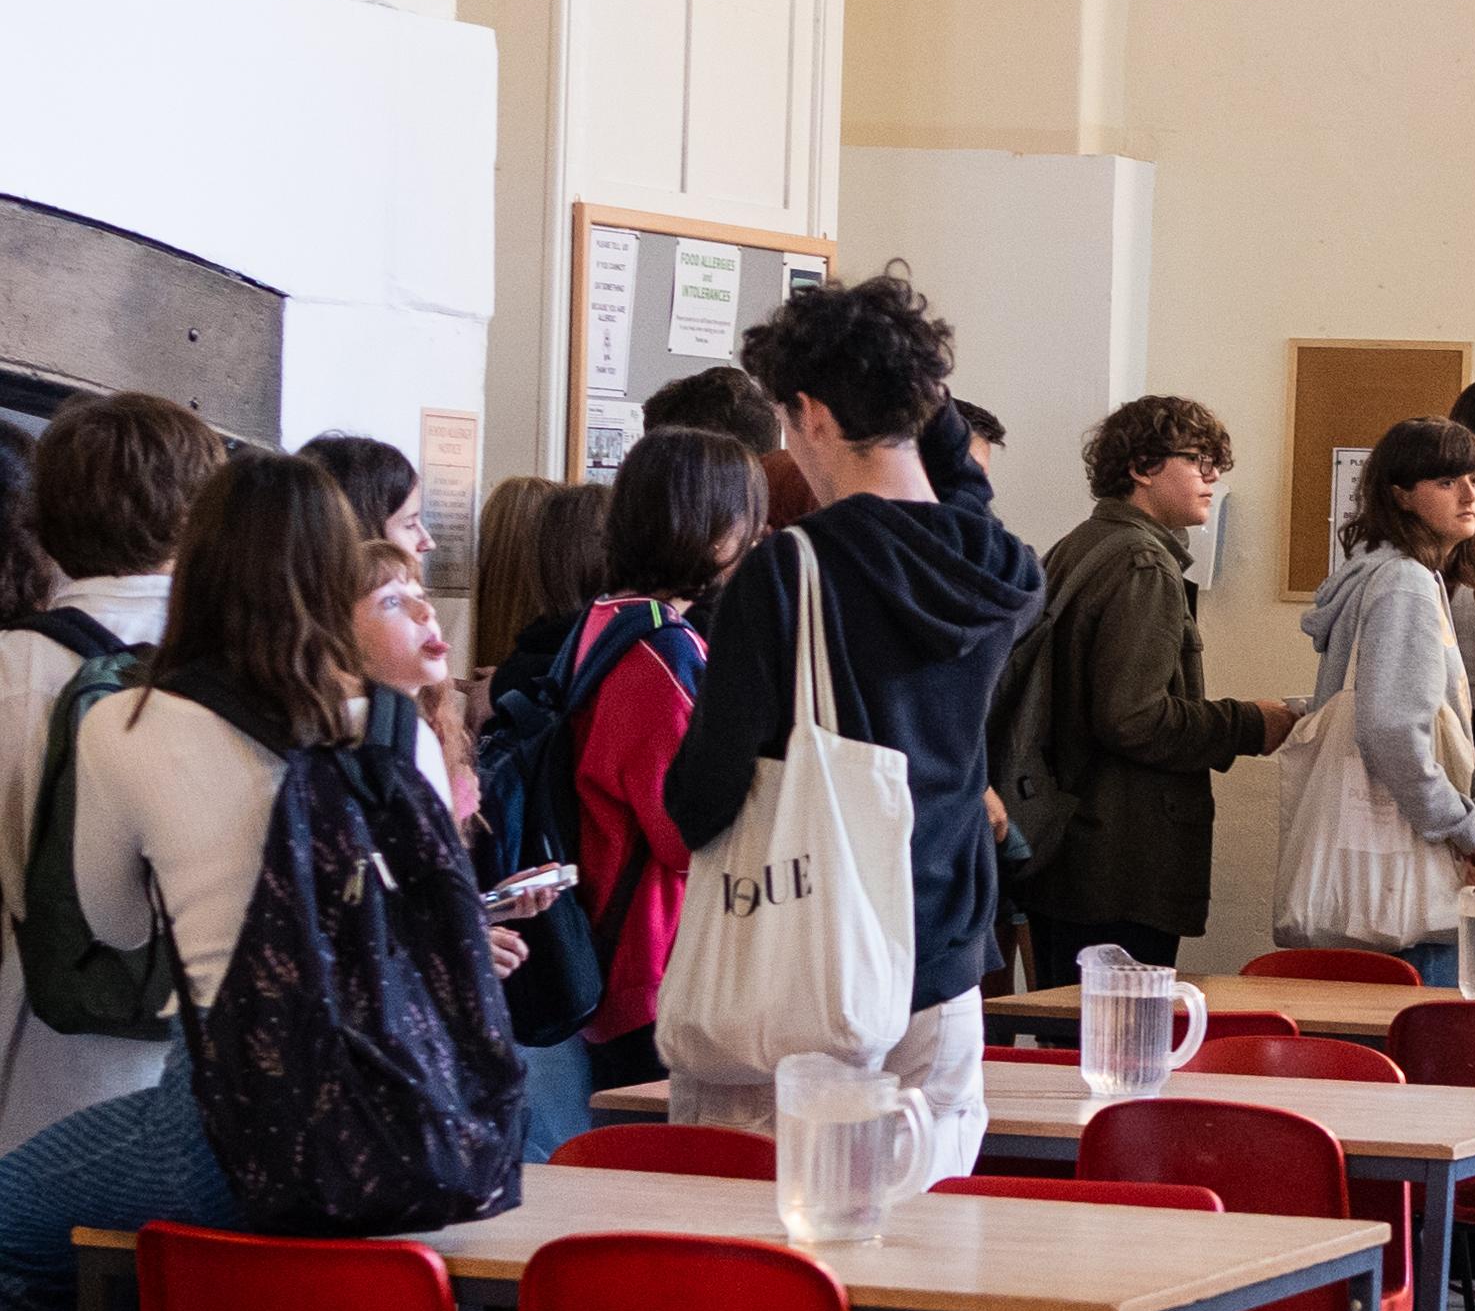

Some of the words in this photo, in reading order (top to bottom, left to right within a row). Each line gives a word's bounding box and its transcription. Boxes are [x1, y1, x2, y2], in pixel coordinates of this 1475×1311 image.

[681, 252, 699, 266] FOOD
[701, 256, 736, 271] ALLERGIES
[681, 285, 731, 302] INTOLERANCES
